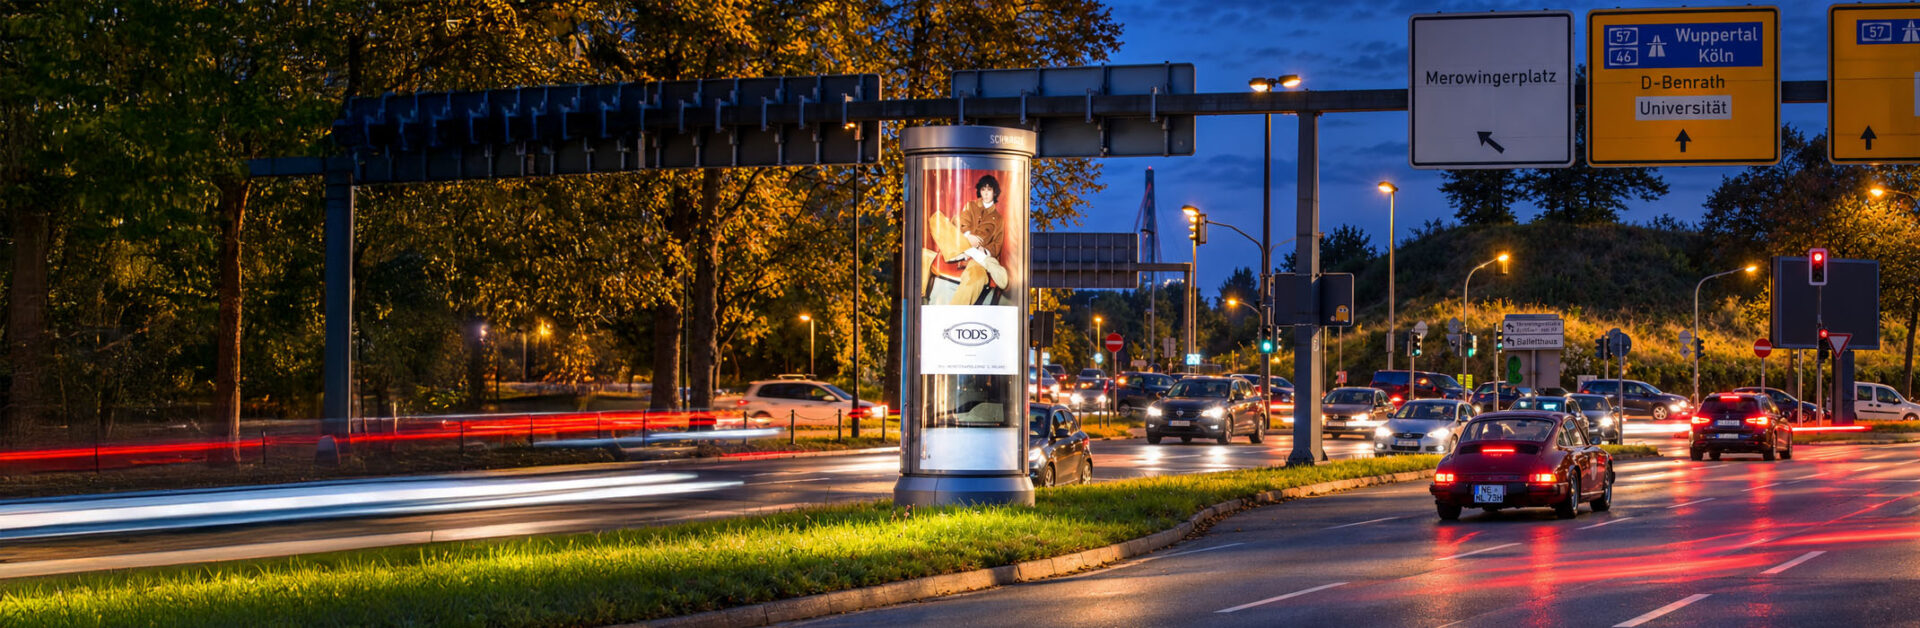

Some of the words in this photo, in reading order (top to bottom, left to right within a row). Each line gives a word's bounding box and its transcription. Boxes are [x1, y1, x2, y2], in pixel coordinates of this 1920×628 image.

[1616, 30, 1631, 42] 57
[1675, 26, 1758, 46] Wuppertal
[1869, 26, 1885, 38] 57
[1616, 51, 1631, 63] 46
[1699, 48, 1734, 63] Köln
[1426, 69, 1557, 88] Merowingerplatz
[1641, 74, 1725, 90] D-Benrath
[1640, 100, 1727, 115] Universität
